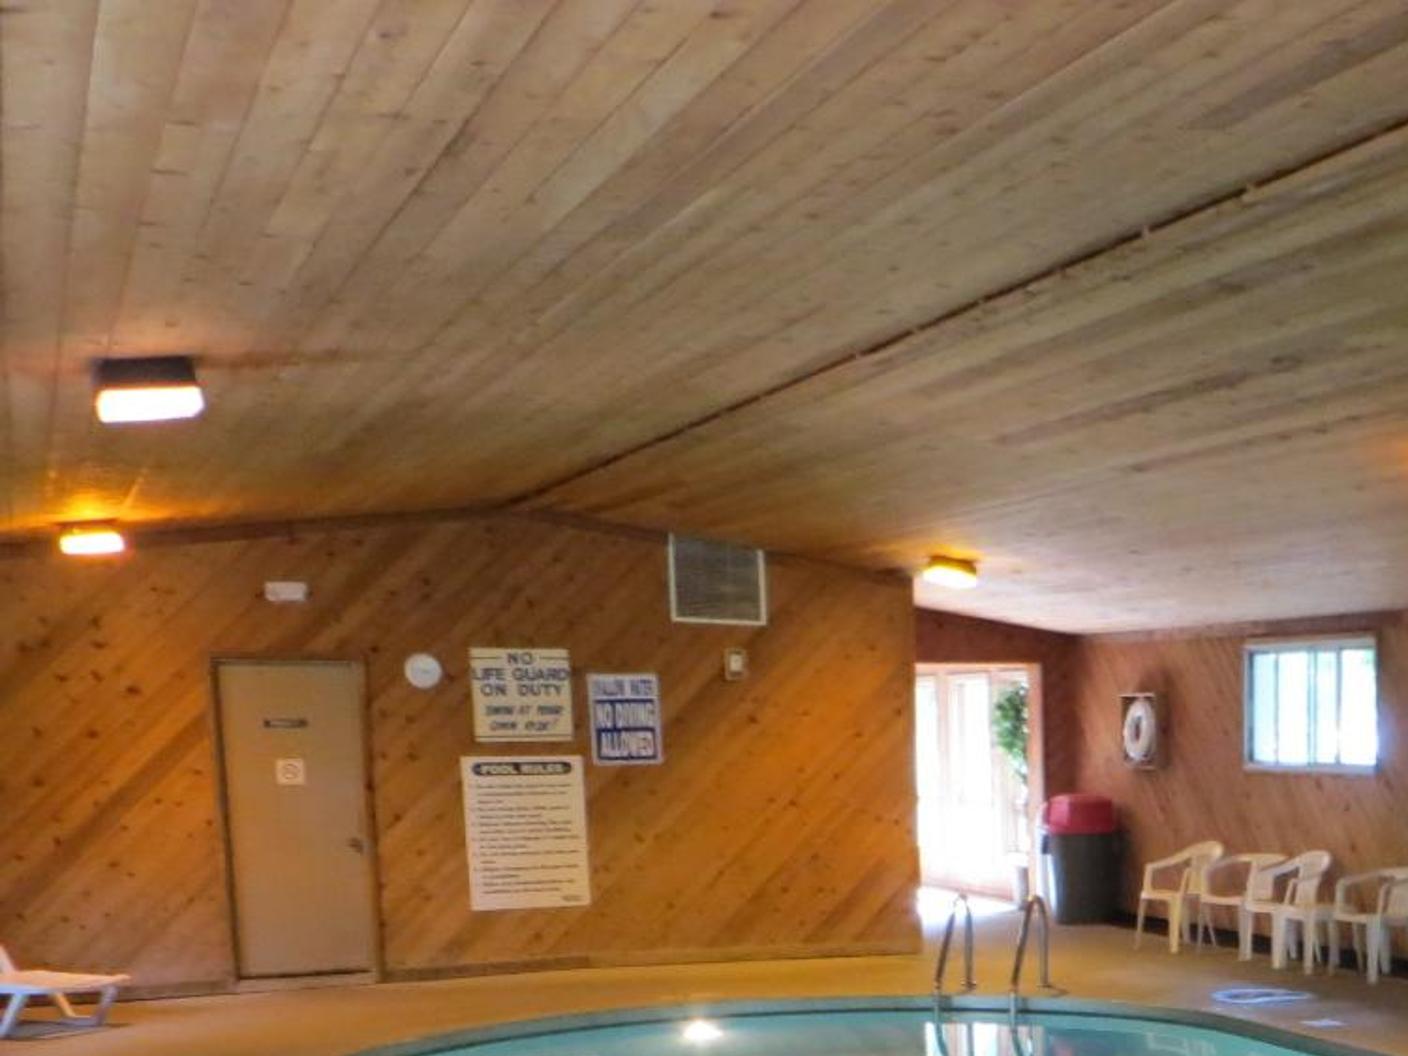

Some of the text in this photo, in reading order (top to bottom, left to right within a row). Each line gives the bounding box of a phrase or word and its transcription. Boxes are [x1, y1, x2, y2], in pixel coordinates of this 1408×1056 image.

[506, 652, 534, 665] NO
[472, 667, 571, 681] LIFE GUARD
[480, 683, 563, 696] ON DUTY
[595, 702, 656, 728] NO DIVING
[600, 731, 655, 757] ALLOWED
[480, 761, 516, 775] POOL
